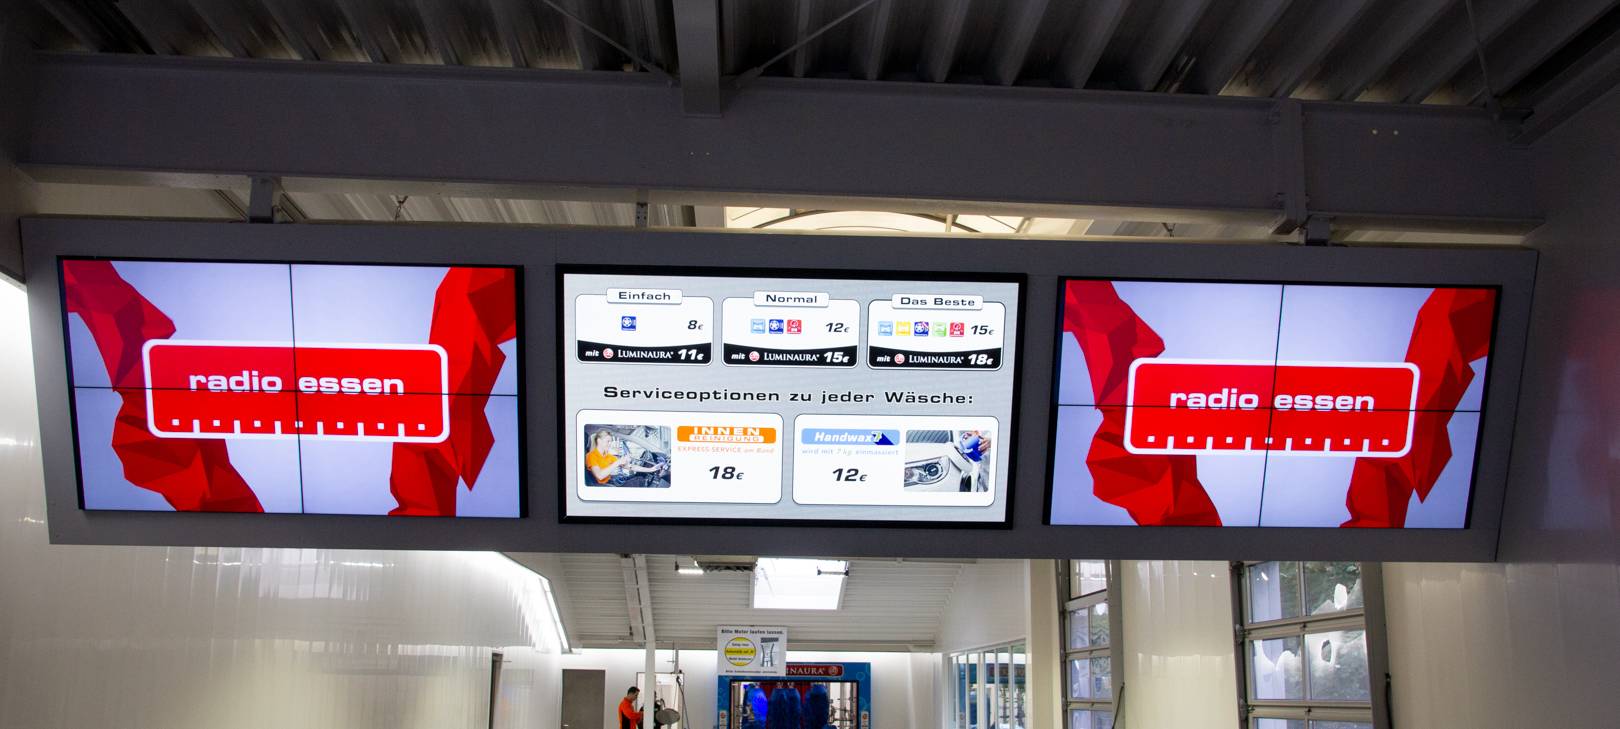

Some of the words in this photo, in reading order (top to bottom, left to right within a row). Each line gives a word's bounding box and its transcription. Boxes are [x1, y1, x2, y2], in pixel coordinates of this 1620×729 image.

[618, 291, 671, 301] Einfach
[766, 294, 817, 304] Normal
[900, 296, 928, 306] Das
[933, 297, 975, 307] Beste
[687, 320, 704, 330] 8€
[825, 322, 850, 333] 12€
[970, 325, 994, 336] 15€
[678, 349, 704, 361] 11€
[731, 352, 746, 360] mit
[823, 351, 850, 363] 15€
[876, 354, 891, 362] mit
[967, 353, 994, 366] 18€
[188, 370, 283, 394] radio
[298, 374, 405, 396] essen
[603, 386, 780, 402] Serviceoptionen
[789, 392, 812, 402] zu
[821, 390, 875, 405] jeder
[885, 391, 974, 404] Wäsche:
[1169, 387, 1259, 410] radio
[1273, 392, 1375, 412] essen
[693, 427, 760, 436] INNEN
[814, 431, 872, 442] Handwax
[708, 465, 744, 480] 18€
[832, 467, 868, 482] 12€
